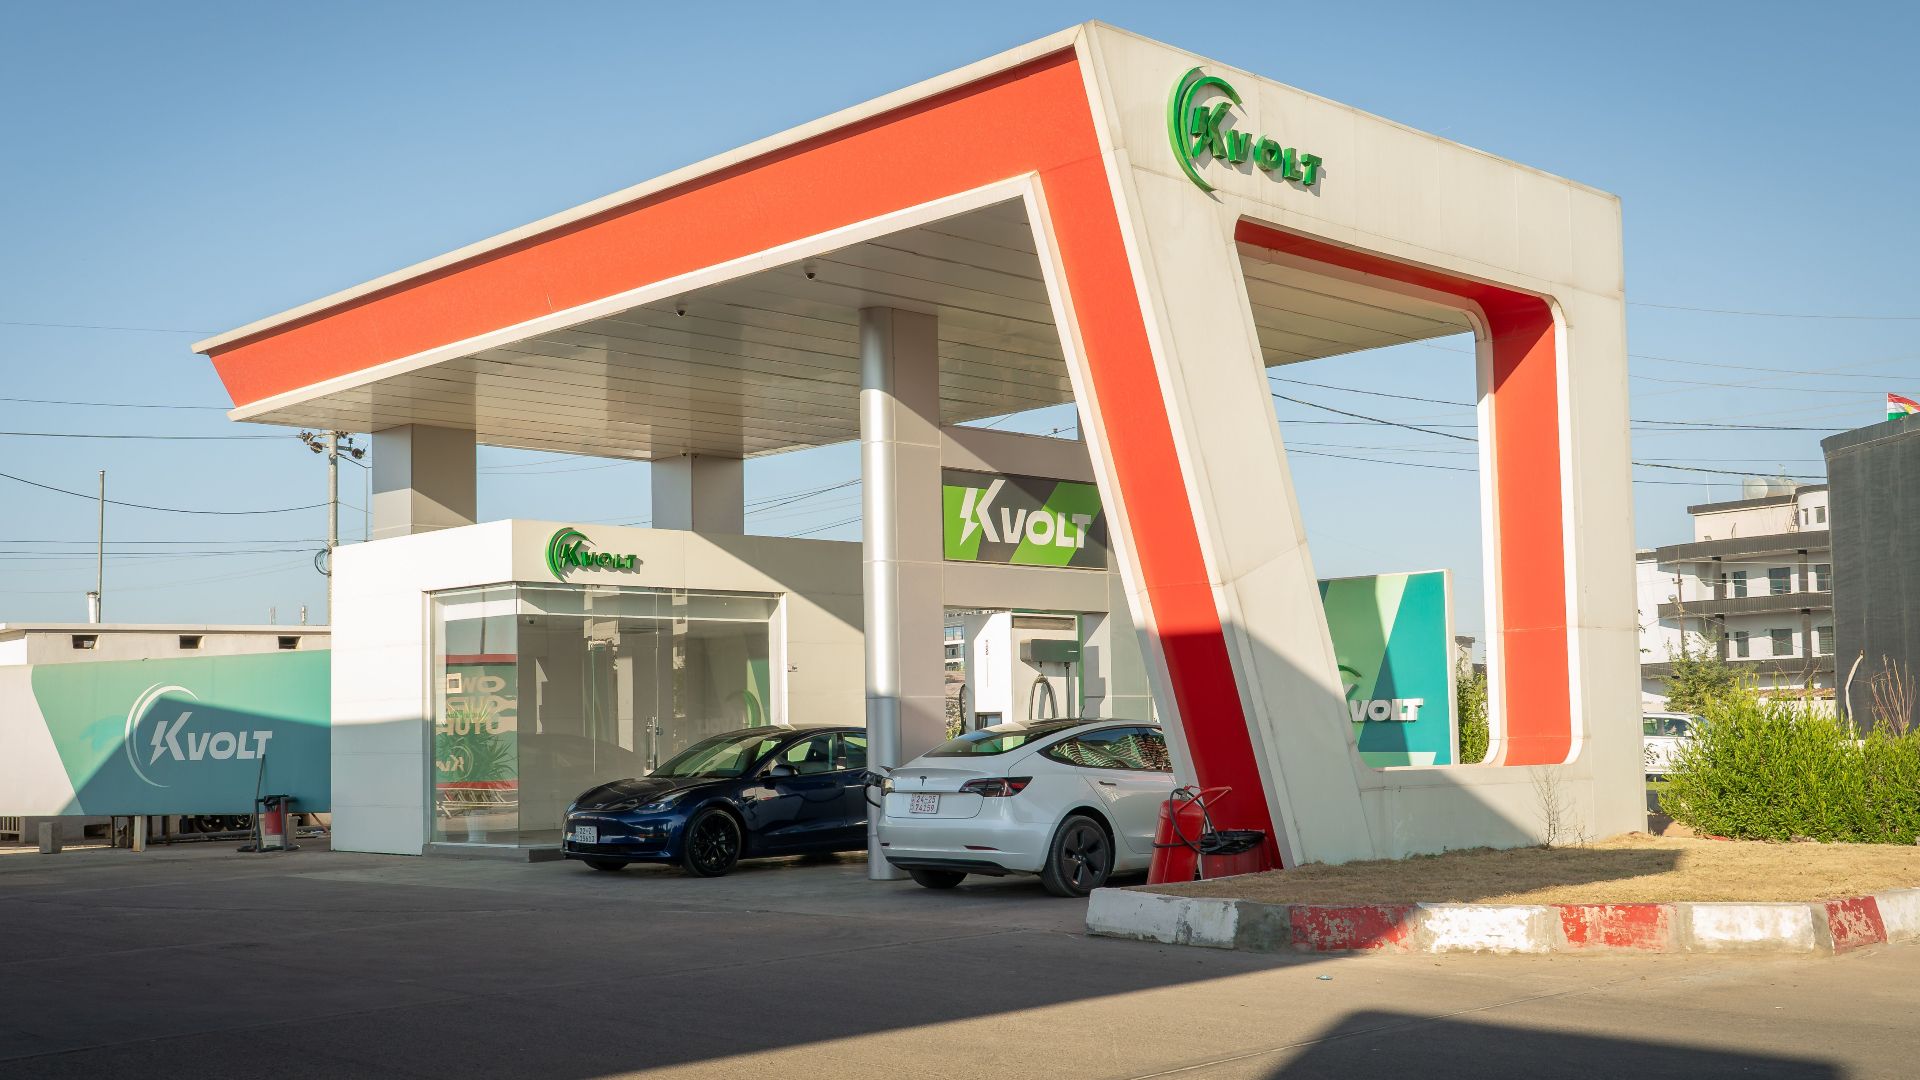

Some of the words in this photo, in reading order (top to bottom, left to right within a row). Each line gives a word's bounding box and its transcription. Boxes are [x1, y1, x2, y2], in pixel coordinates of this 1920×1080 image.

[1191, 102, 1322, 186] KVOLT
[960, 479, 1092, 548] KVOLT
[560, 540, 638, 569] KVOLT
[150, 711, 273, 766] KVOLT
